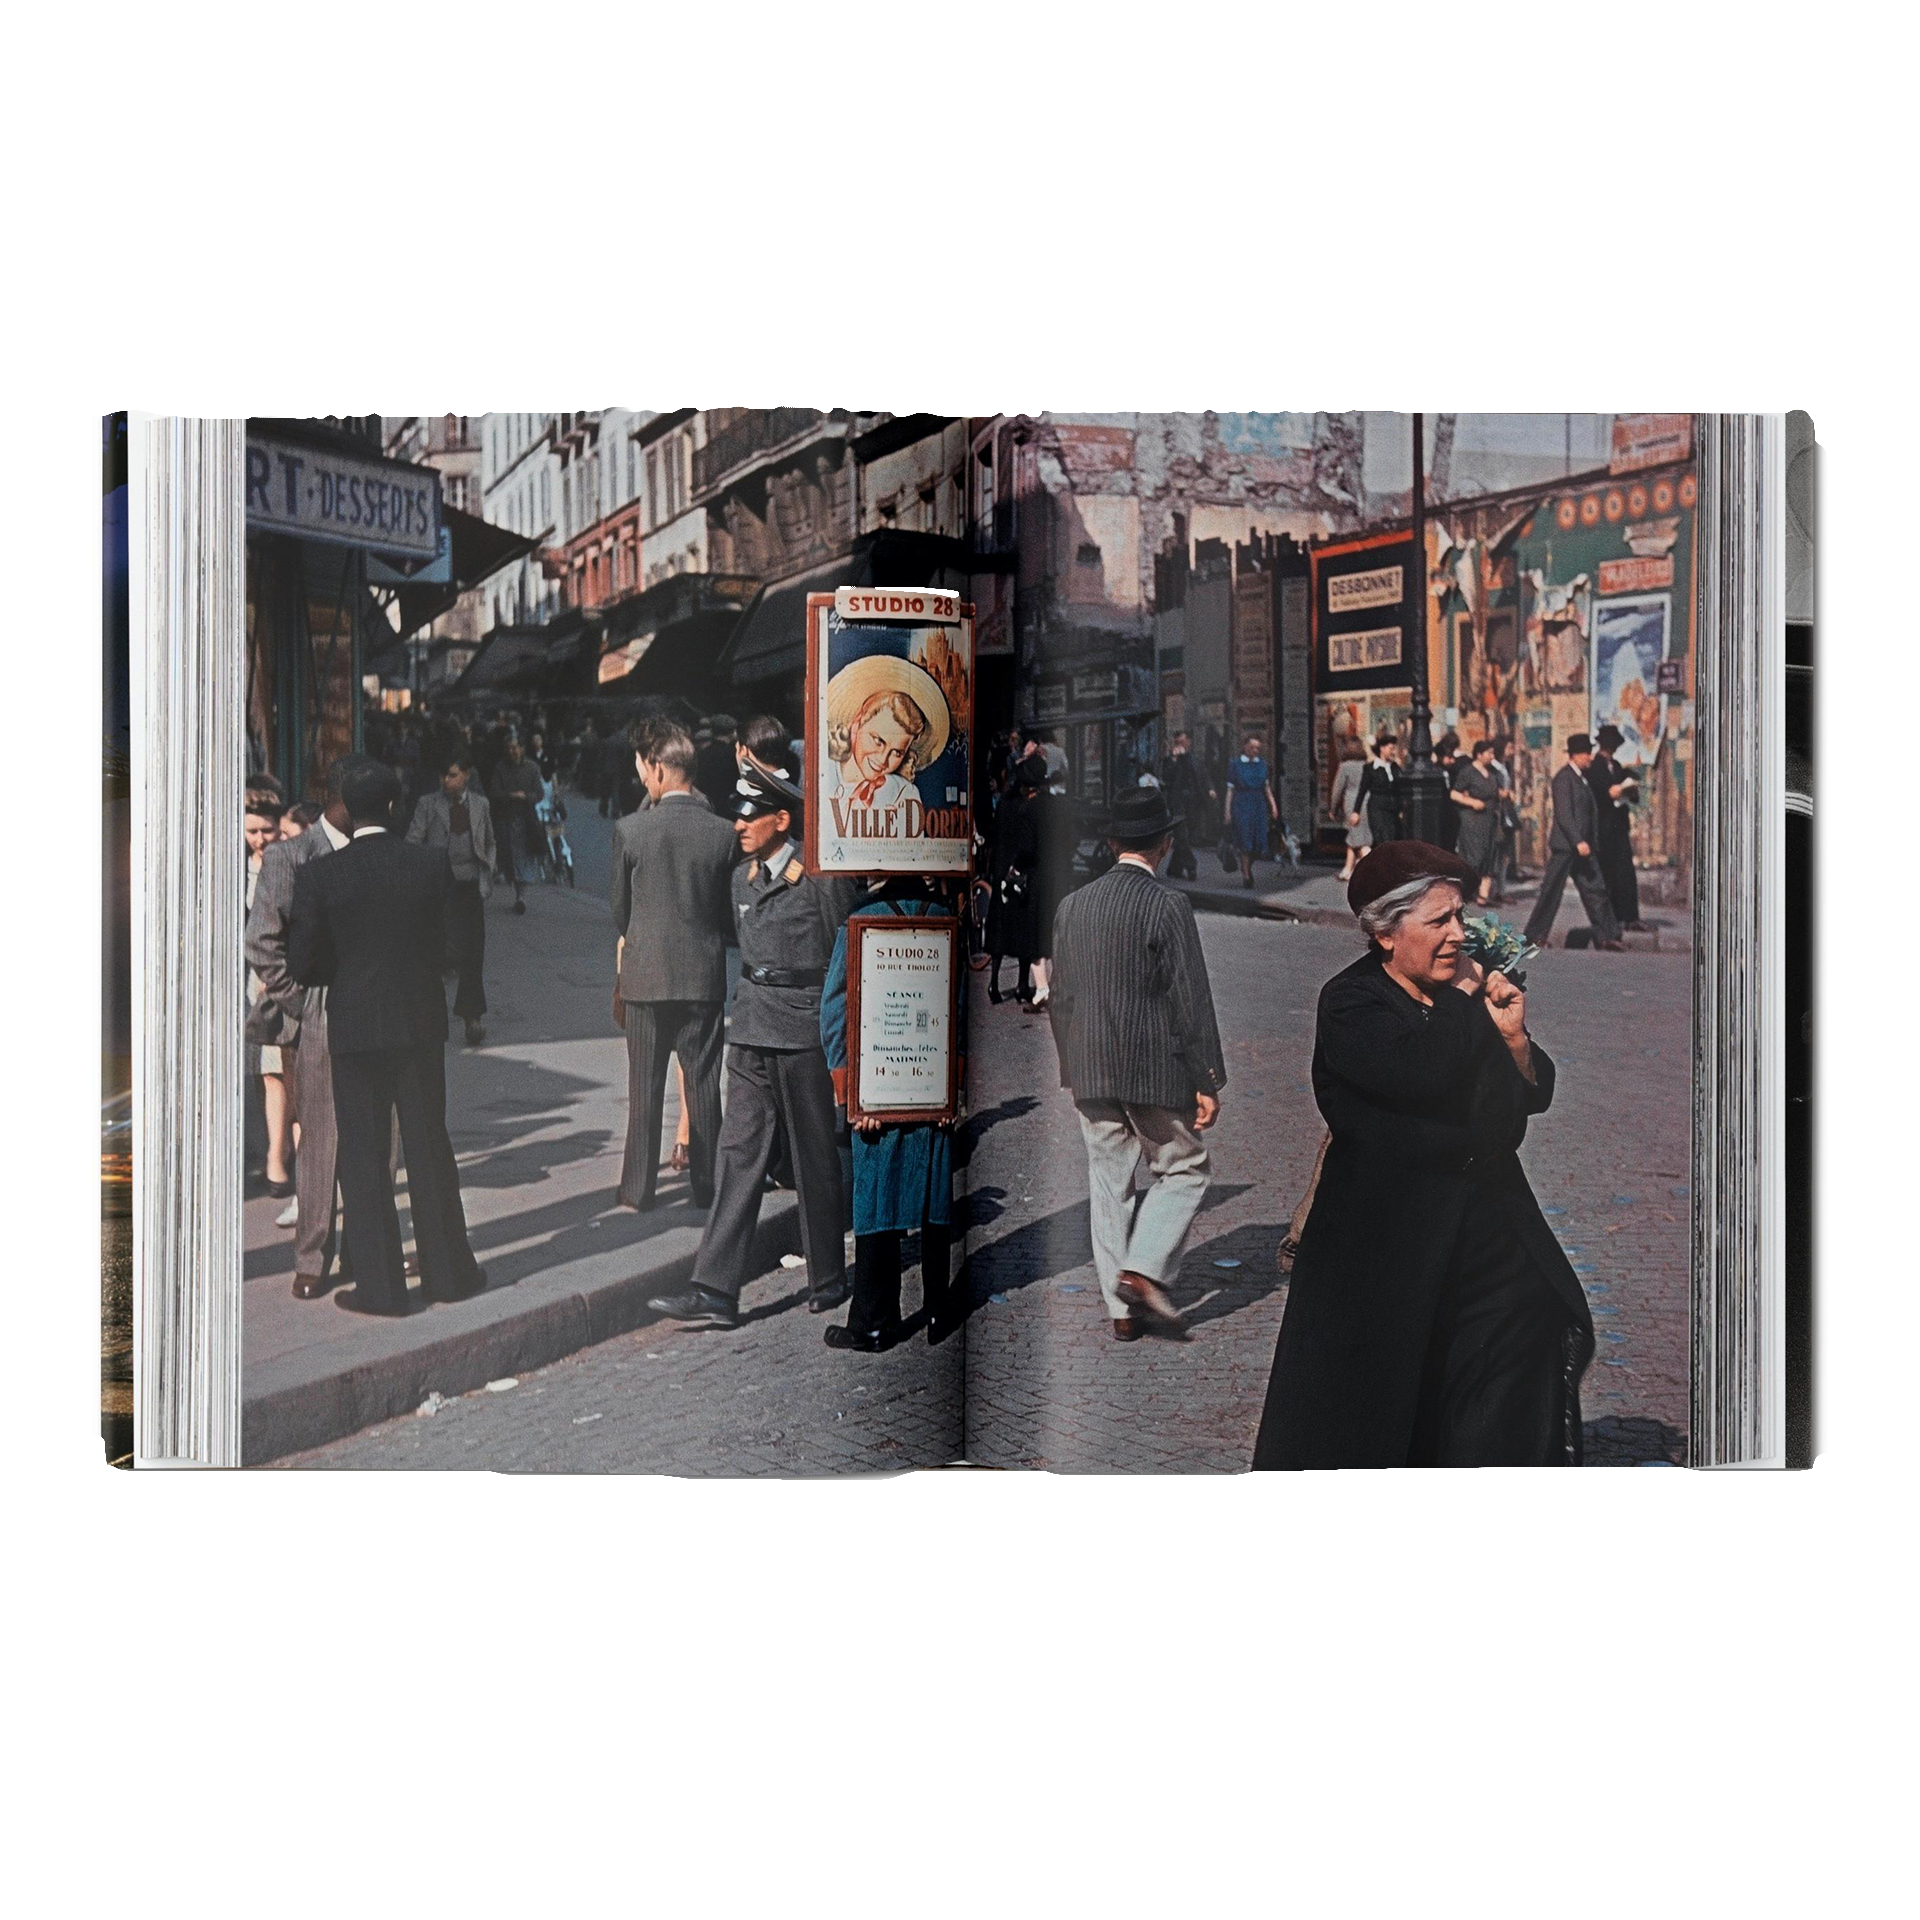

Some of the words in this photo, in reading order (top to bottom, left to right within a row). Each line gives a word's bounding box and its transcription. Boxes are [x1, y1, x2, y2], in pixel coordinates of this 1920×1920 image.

[319, 469, 428, 535] DESSERTS
[849, 596, 925, 613] STUDIO
[933, 596, 954, 617] 28
[876, 947, 924, 959] STUDIO
[927, 948, 940, 960] 28
[875, 1066, 886, 1076] 14
[912, 1066, 923, 1077] 16
